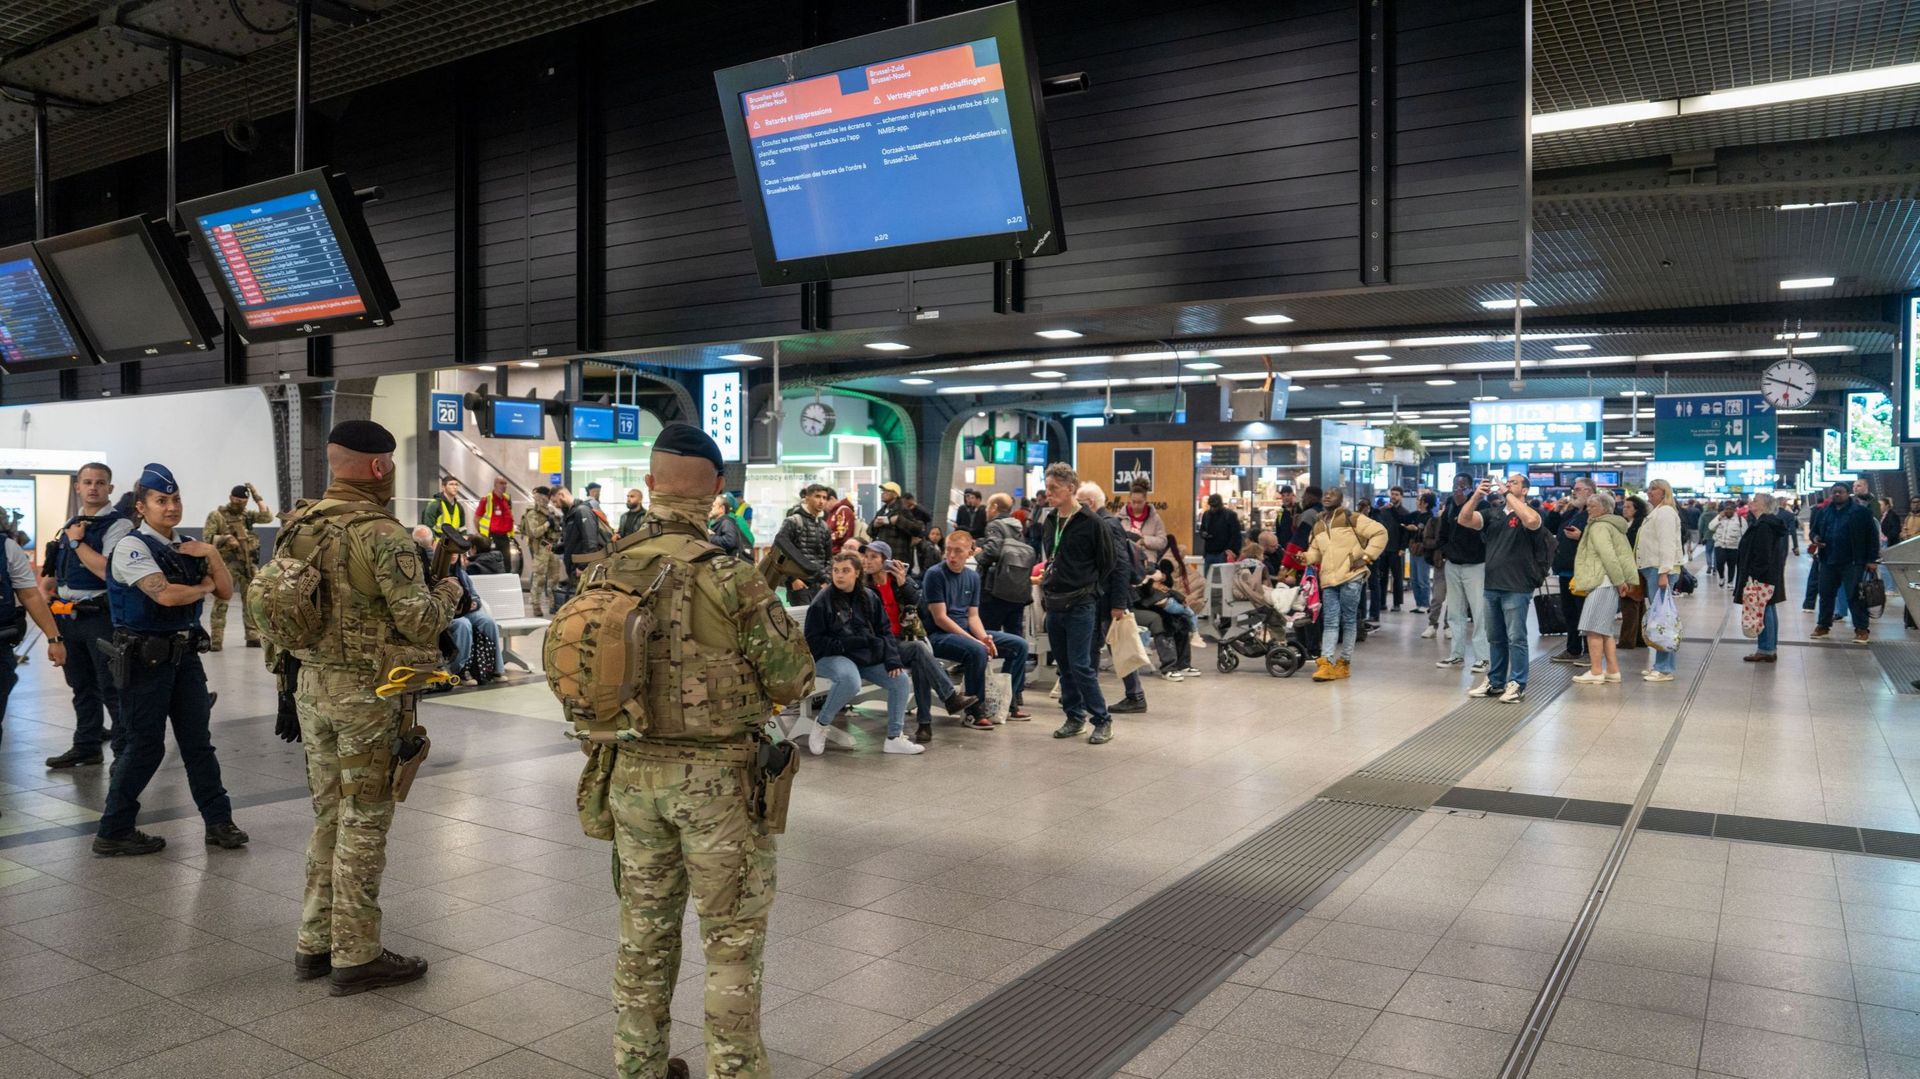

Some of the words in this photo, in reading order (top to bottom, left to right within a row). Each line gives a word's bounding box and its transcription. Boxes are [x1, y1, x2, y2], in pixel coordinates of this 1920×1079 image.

[870, 64, 904, 77] Brussel-Zuid
[871, 70, 911, 84] Brussel-Noord
[887, 87, 928, 101] Vertragingen
[940, 75, 986, 92] afschaffingen
[749, 91, 784, 104] Bruxelles-Midi
[751, 98, 787, 110] Bruxelles-Nord
[765, 116, 786, 126] Retards
[788, 114, 793, 122] et
[794, 107, 832, 121] suppressions
[882, 114, 909, 124] schermen
[917, 110, 929, 120] plan
[930, 108, 935, 117] je
[936, 106, 946, 114] reis
[957, 100, 982, 110] nmbs.be
[790, 133, 814, 142] annonces,
[815, 128, 838, 136] consultez
[878, 125, 909, 135] NMBS-app.
[759, 149, 778, 158] planifiez
[847, 135, 860, 143] l'app
[882, 146, 905, 155] Oorzaak:
[907, 140, 941, 151] tussenkomst
[962, 129, 1000, 141] ordediensten
[884, 154, 919, 165] Brussel-Zuid.
[783, 173, 811, 182] intervention
[821, 168, 837, 176] forces
[846, 164, 861, 172] l'ordre
[767, 186, 802, 195] Bruxelles-Midi.
[1007, 216, 1022, 225] p.2/2
[874, 233, 888, 242] p.2/2
[440, 409, 455, 422] 20
[724, 384, 732, 444] HAMON
[621, 421, 632, 432] 19
[1725, 441, 1742, 455] M
[1116, 471, 1150, 483] JAVA
